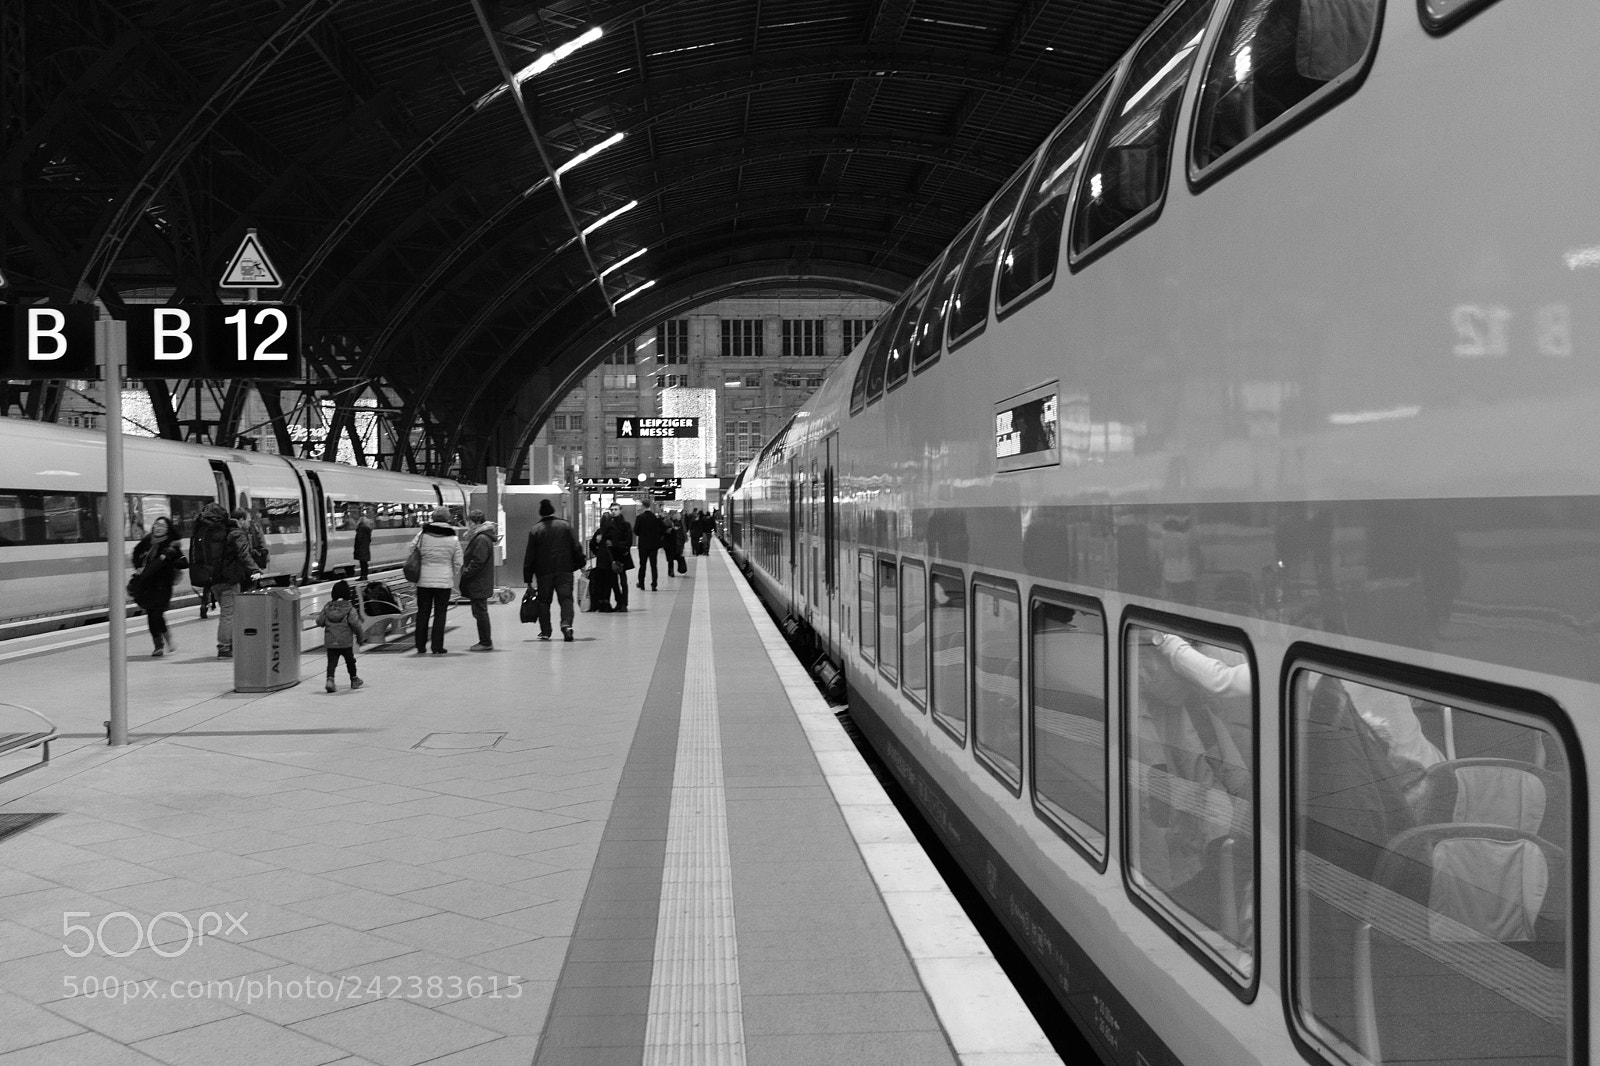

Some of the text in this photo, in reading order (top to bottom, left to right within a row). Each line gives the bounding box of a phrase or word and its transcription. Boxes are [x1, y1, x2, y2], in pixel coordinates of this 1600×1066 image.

[28, 308, 68, 361] B
[153, 308, 288, 361] B 12
[639, 418, 693, 428] LEIPZIGER
[639, 428, 675, 437] MESSE
[271, 622, 281, 674] Abfall
